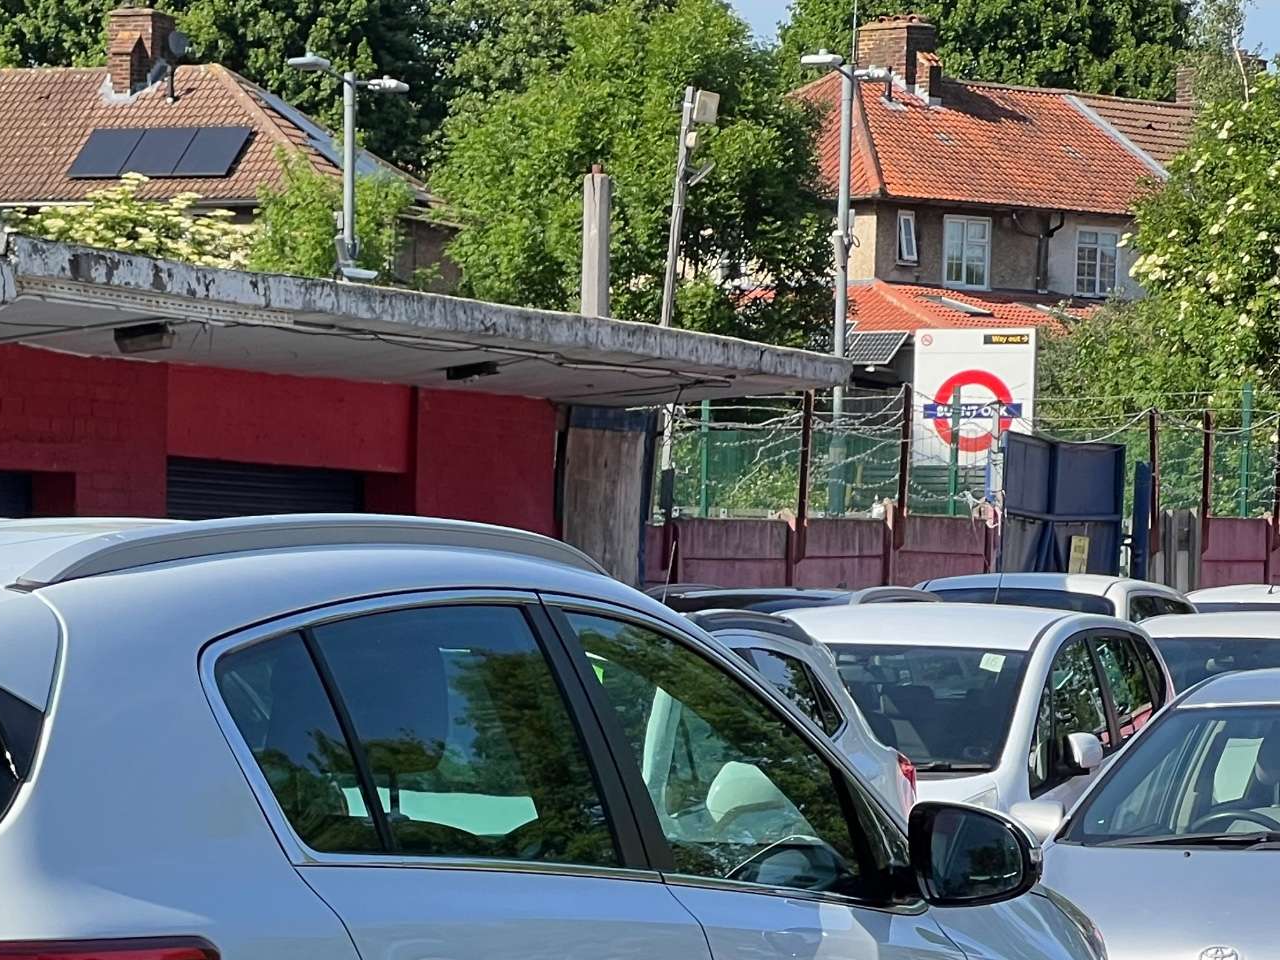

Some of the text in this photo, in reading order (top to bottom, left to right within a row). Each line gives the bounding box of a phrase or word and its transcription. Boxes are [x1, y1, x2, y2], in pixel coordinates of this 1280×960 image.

[991, 335, 1021, 344] Way out
[936, 404, 1008, 417] BUNT OK
